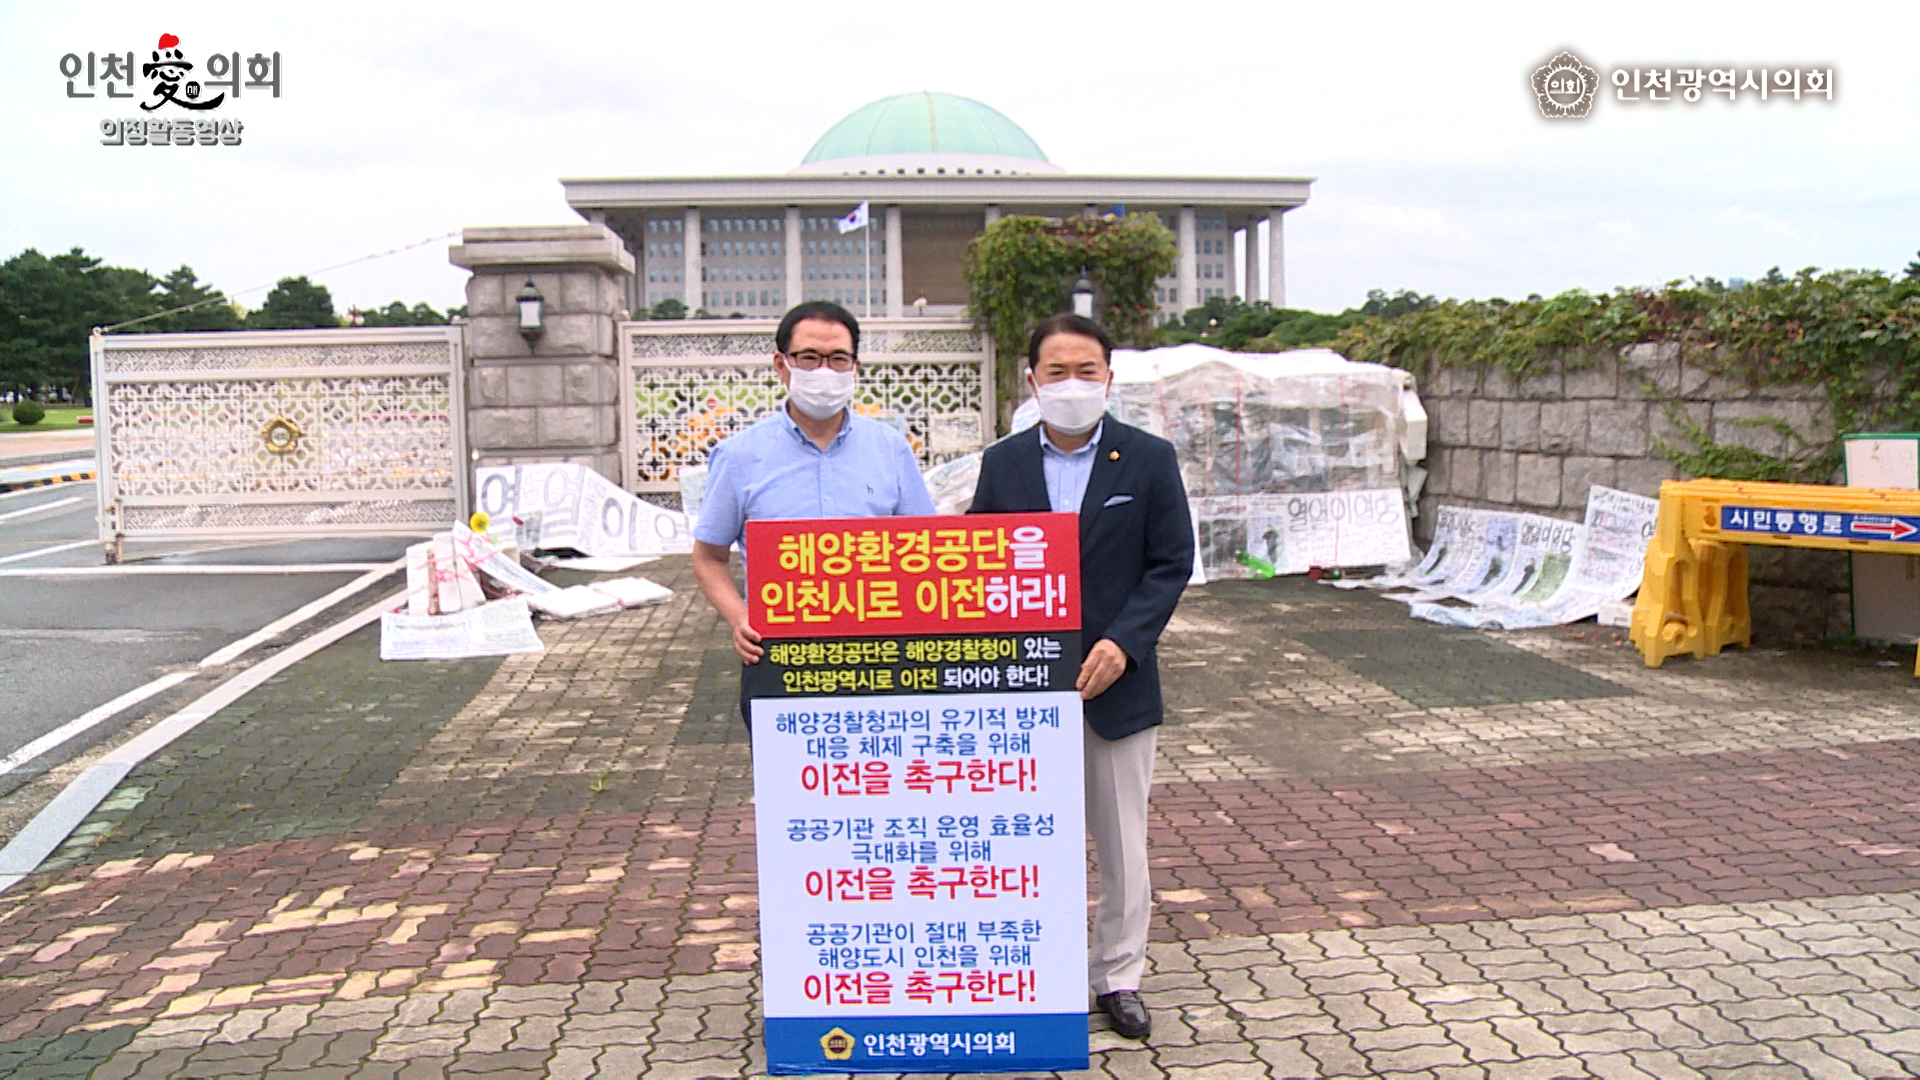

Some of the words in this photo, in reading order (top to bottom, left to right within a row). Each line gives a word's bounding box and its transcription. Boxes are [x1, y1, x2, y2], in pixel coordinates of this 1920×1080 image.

[1730, 509, 1843, 535] 시민통행로
[778, 526, 1048, 575] 해양환경공단을
[761, 578, 903, 623] 인천시로
[915, 574, 1068, 620] 이전하라!
[769, 641, 901, 666] 해양환경공단은
[905, 638, 1018, 662] 해양경찰청이
[1023, 637, 1062, 659] 있는
[782, 668, 894, 693] 인천광역시로
[901, 667, 938, 690] 이전
[943, 666, 1000, 689] 되어야
[1006, 665, 1050, 687] 한다!
[775, 708, 931, 735] 해양경찰청과의
[940, 707, 1006, 731] 유기적
[1016, 706, 1060, 730] 방제
[806, 736, 850, 760] 대응
[859, 735, 903, 758] 체제
[911, 733, 979, 756] 구축을
[988, 732, 1031, 755] 위해
[801, 760, 893, 795] 이전을
[903, 758, 1038, 793] 촉구한다!
[786, 817, 875, 842] 공공기관
[884, 817, 927, 839] 조직
[936, 815, 980, 838] 운영
[988, 813, 1055, 837] 효율성
[851, 841, 939, 864] 극대화를
[948, 839, 992, 863] 위해
[805, 866, 896, 901] 이전을
[906, 864, 1040, 900] 촉구한다!
[806, 922, 915, 946] 공공기관이
[924, 921, 966, 944] 절대
[976, 919, 1043, 943] 부족한
[818, 947, 905, 970] 해양도시
[914, 945, 979, 968] 인천을
[988, 944, 1032, 967] 위해
[803, 971, 894, 1006] 이전을
[904, 969, 1037, 1004] 촉구한다!
[863, 1031, 1016, 1057] 인천광역시의회
